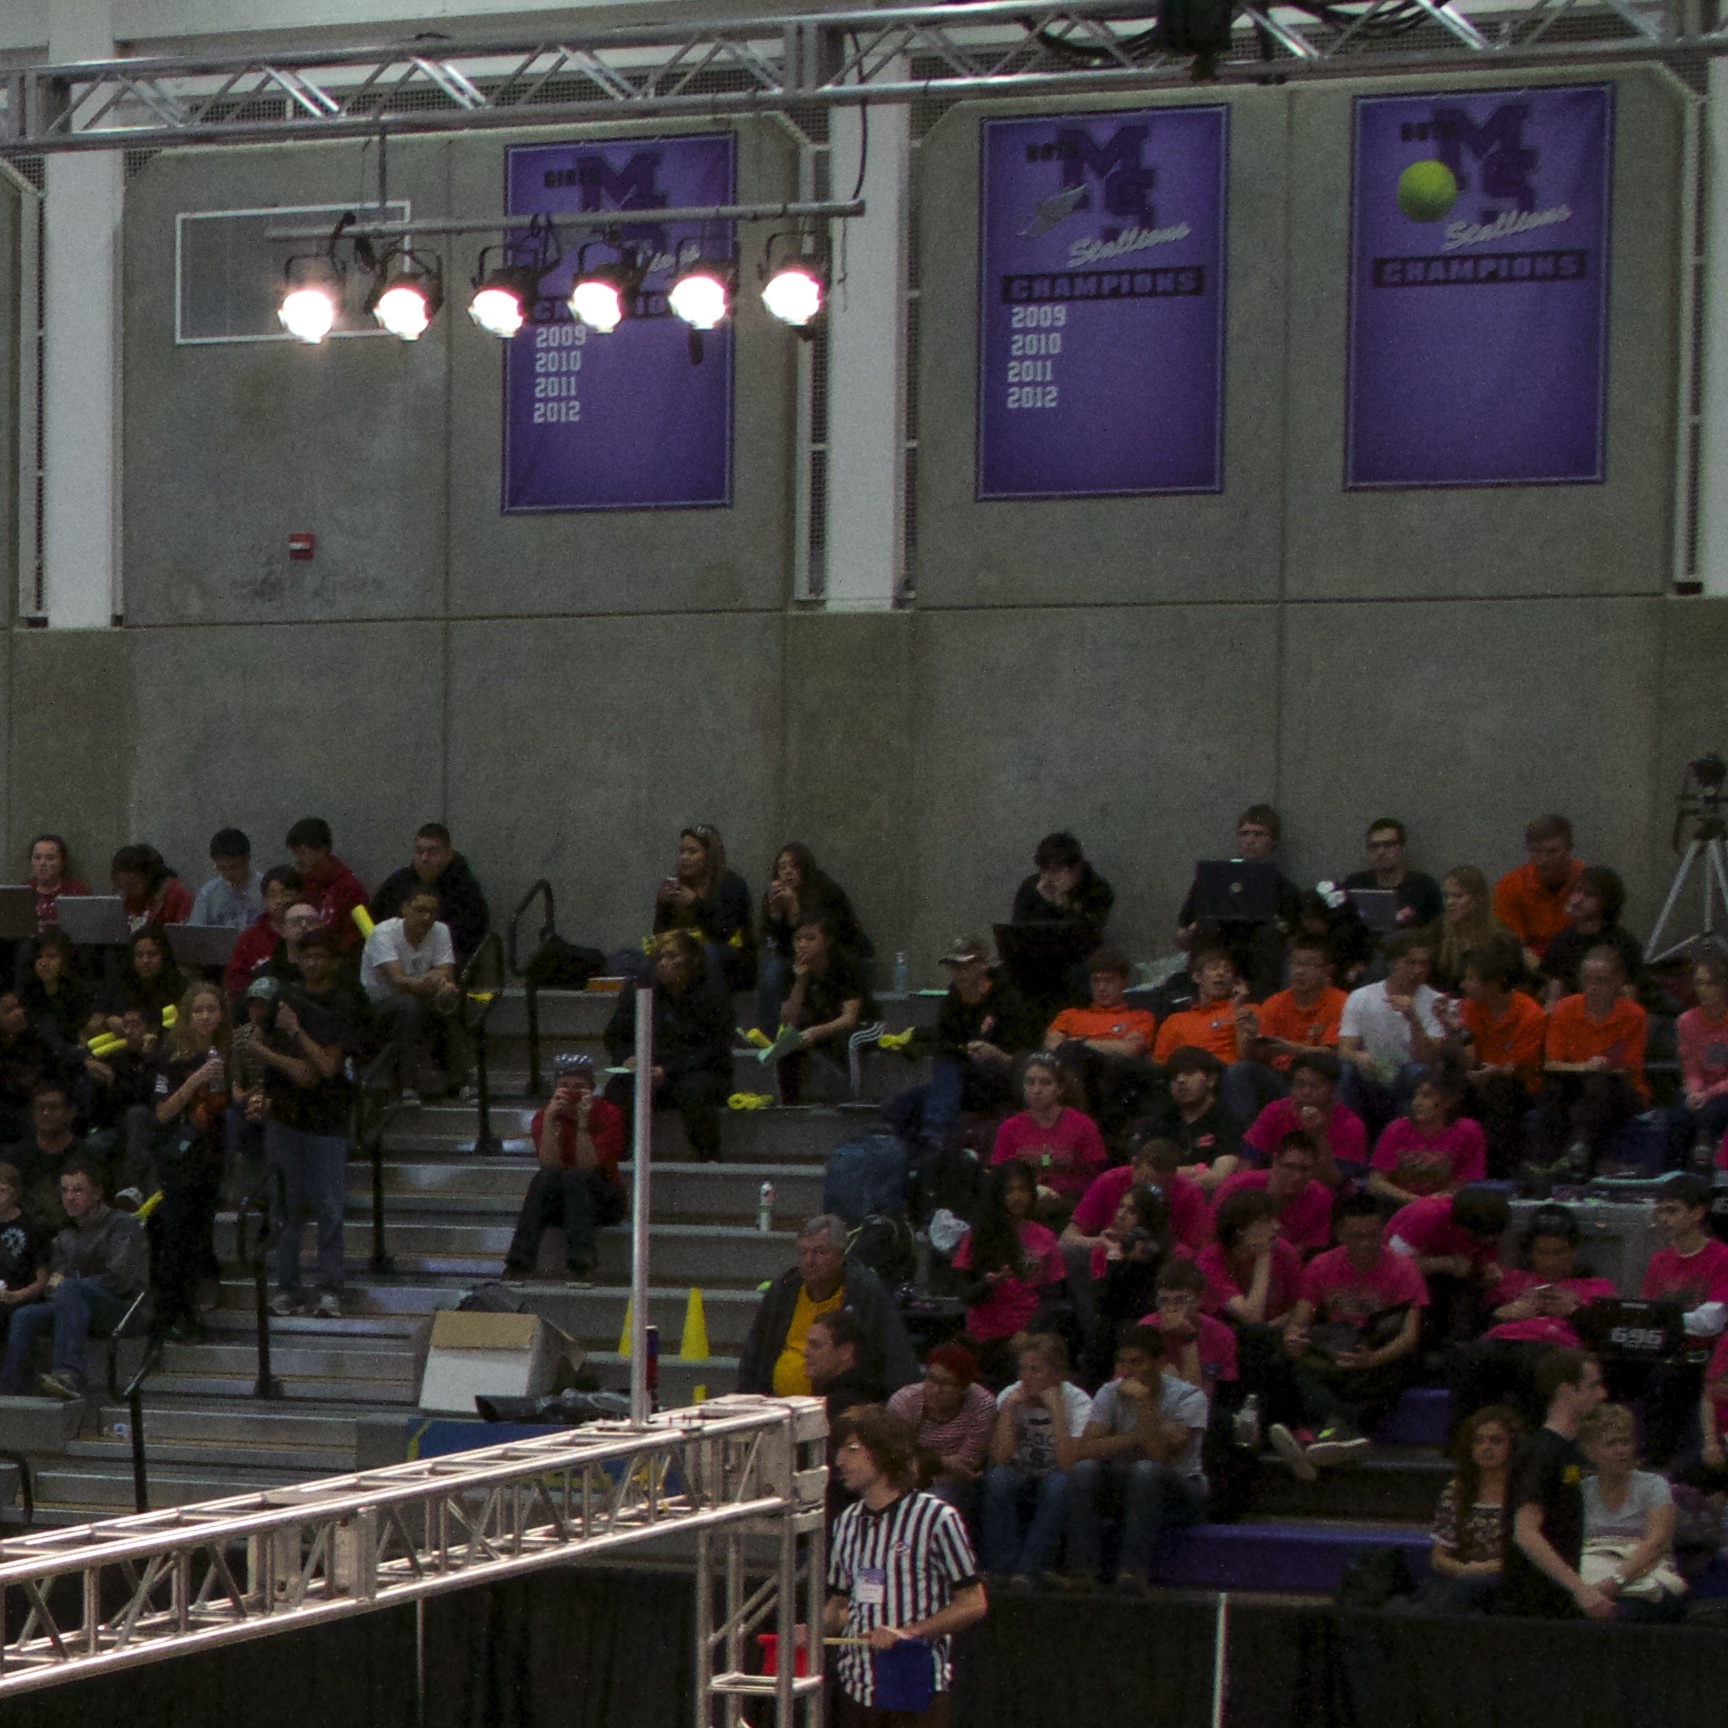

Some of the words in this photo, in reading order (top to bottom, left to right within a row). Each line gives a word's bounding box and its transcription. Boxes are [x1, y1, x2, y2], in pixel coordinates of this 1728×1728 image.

[1067, 223, 1191, 268] Stallions
[1382, 254, 1578, 284] CHAMPIONS
[1010, 269, 1198, 300] CHAMPIONS
[1011, 304, 1067, 329] 2009
[536, 325, 587, 348] 2009
[1010, 332, 1062, 357] 2010
[535, 350, 582, 373] 2010
[1007, 360, 1054, 384] 2011
[534, 376, 578, 398] 2011
[1006, 386, 1059, 410] 2012
[533, 401, 581, 424] 2012
